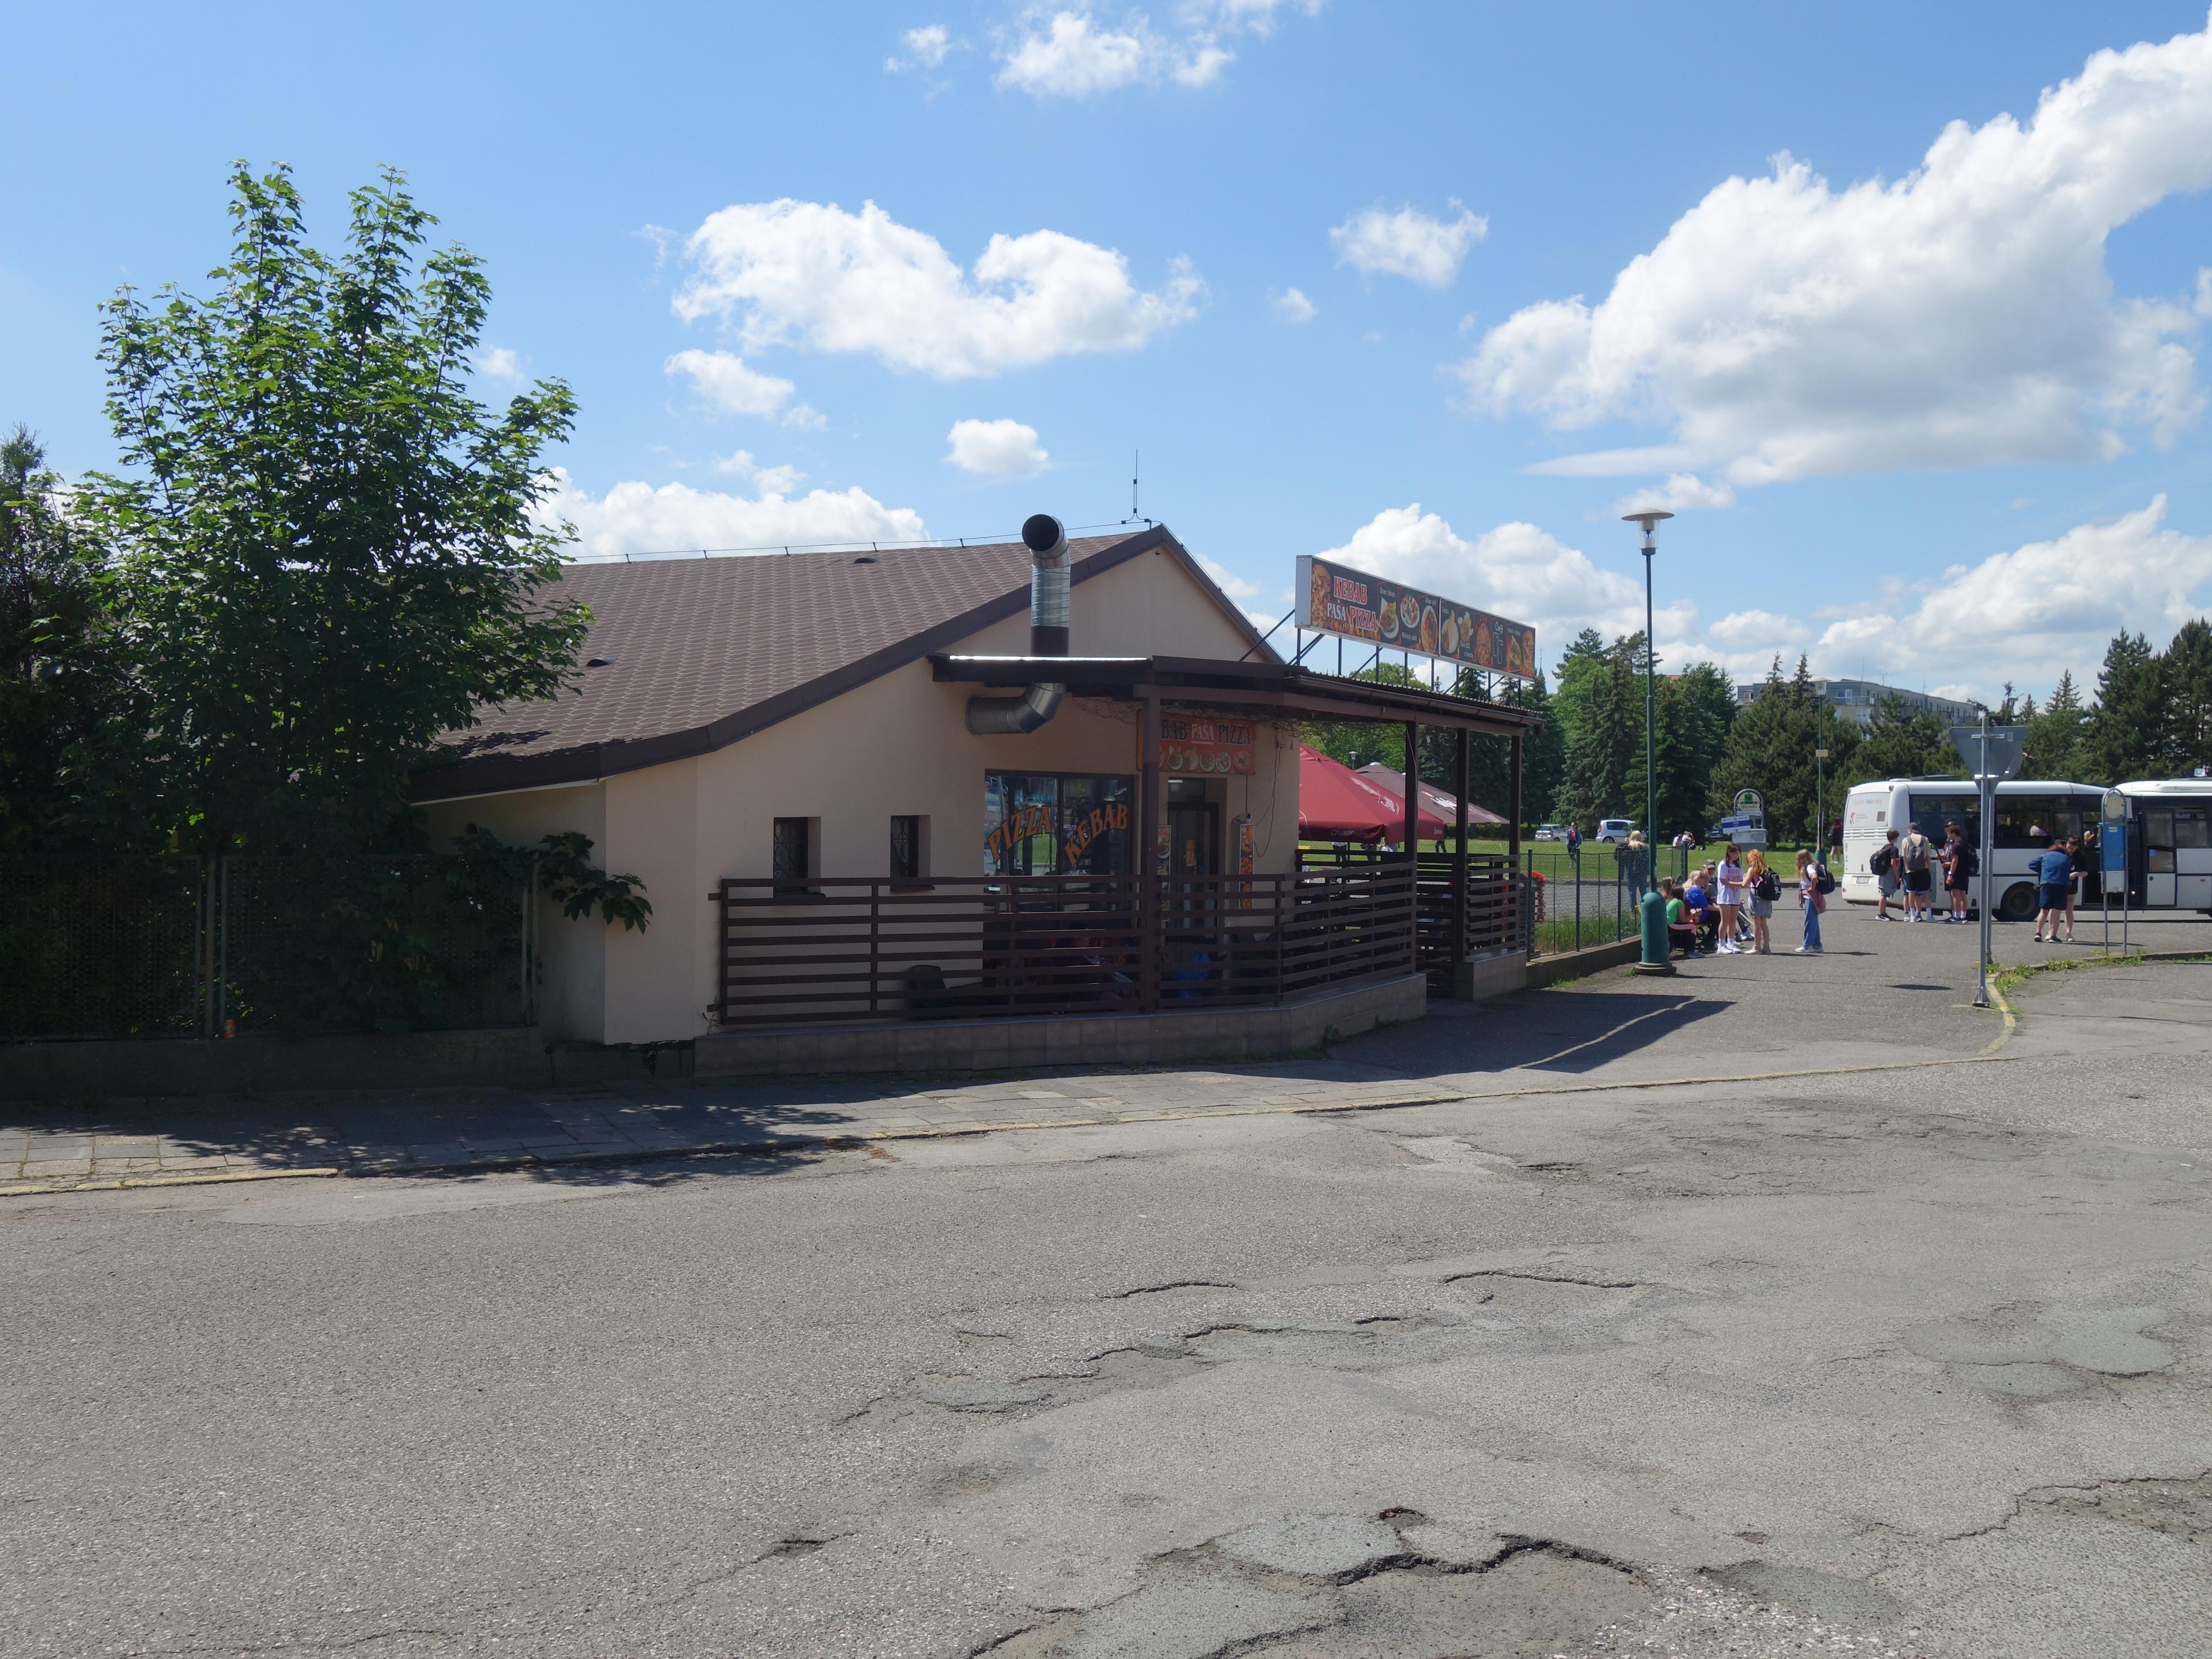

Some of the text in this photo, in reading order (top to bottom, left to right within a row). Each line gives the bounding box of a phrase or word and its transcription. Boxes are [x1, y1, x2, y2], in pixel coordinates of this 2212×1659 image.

[1333, 576, 1368, 605] KEBAB
[1327, 599, 1379, 632] PAŠA PIZZA
[1161, 718, 1187, 741] BAB
[1218, 723, 1252, 746] PIZZA
[987, 803, 1128, 867] PIZZA KEBAB
